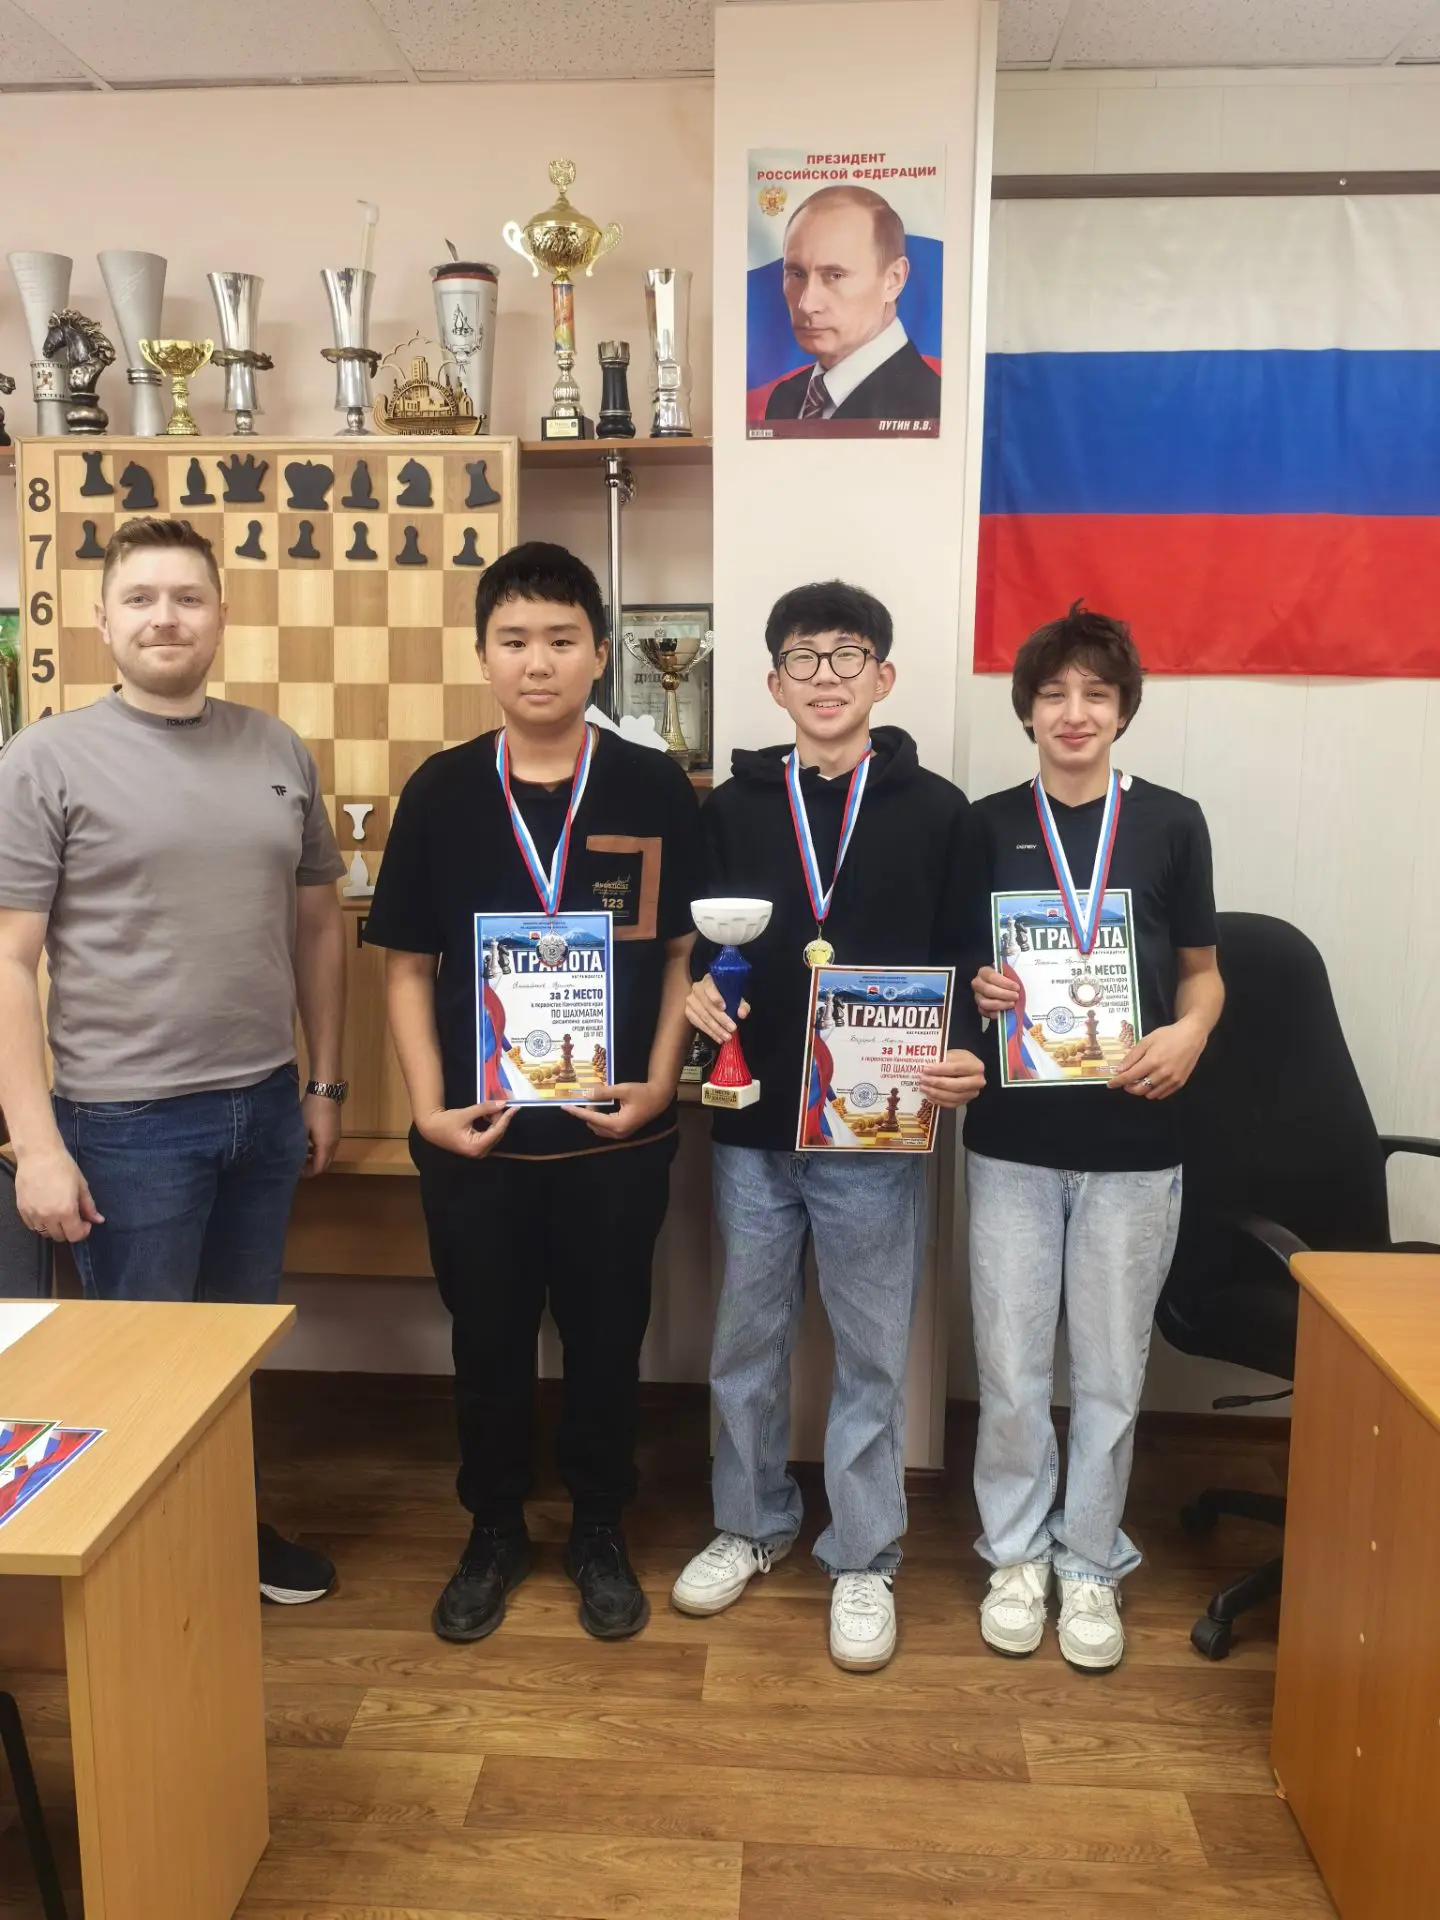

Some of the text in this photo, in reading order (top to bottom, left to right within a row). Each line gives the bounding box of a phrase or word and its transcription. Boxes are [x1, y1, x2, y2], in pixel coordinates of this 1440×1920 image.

[806, 153, 886, 165] ПРЕЗИДЕНТ
[757, 166, 937, 180] РОССИЙСКОЙ ФЕДЕРАЦИИ
[878, 420, 932, 431] ПУТИН В.В.
[28, 477, 51, 512] 8
[29, 534, 52, 570] 7
[30, 591, 53, 626] 6
[31, 648, 55, 683] 5
[634, 672, 689, 685] ДИПМ
[272, 784, 287, 796] TF
[602, 898, 624, 909] 123
[1035, 927, 1124, 949] ГРАТА
[517, 951, 603, 972] ГРОТА
[1071, 968, 1083, 976] за
[1094, 964, 1127, 976] МЕСТО
[550, 989, 604, 1000] за 2 МЕСТО
[1102, 984, 1129, 993] МАТАМ
[551, 1008, 604, 1018] ПО ШАХМАТАМ
[851, 1005, 940, 1028] ГРАМОТА
[881, 1045, 938, 1056] за 1 МЕСТО
[880, 1063, 924, 1074] ПО ШАХМАТ
